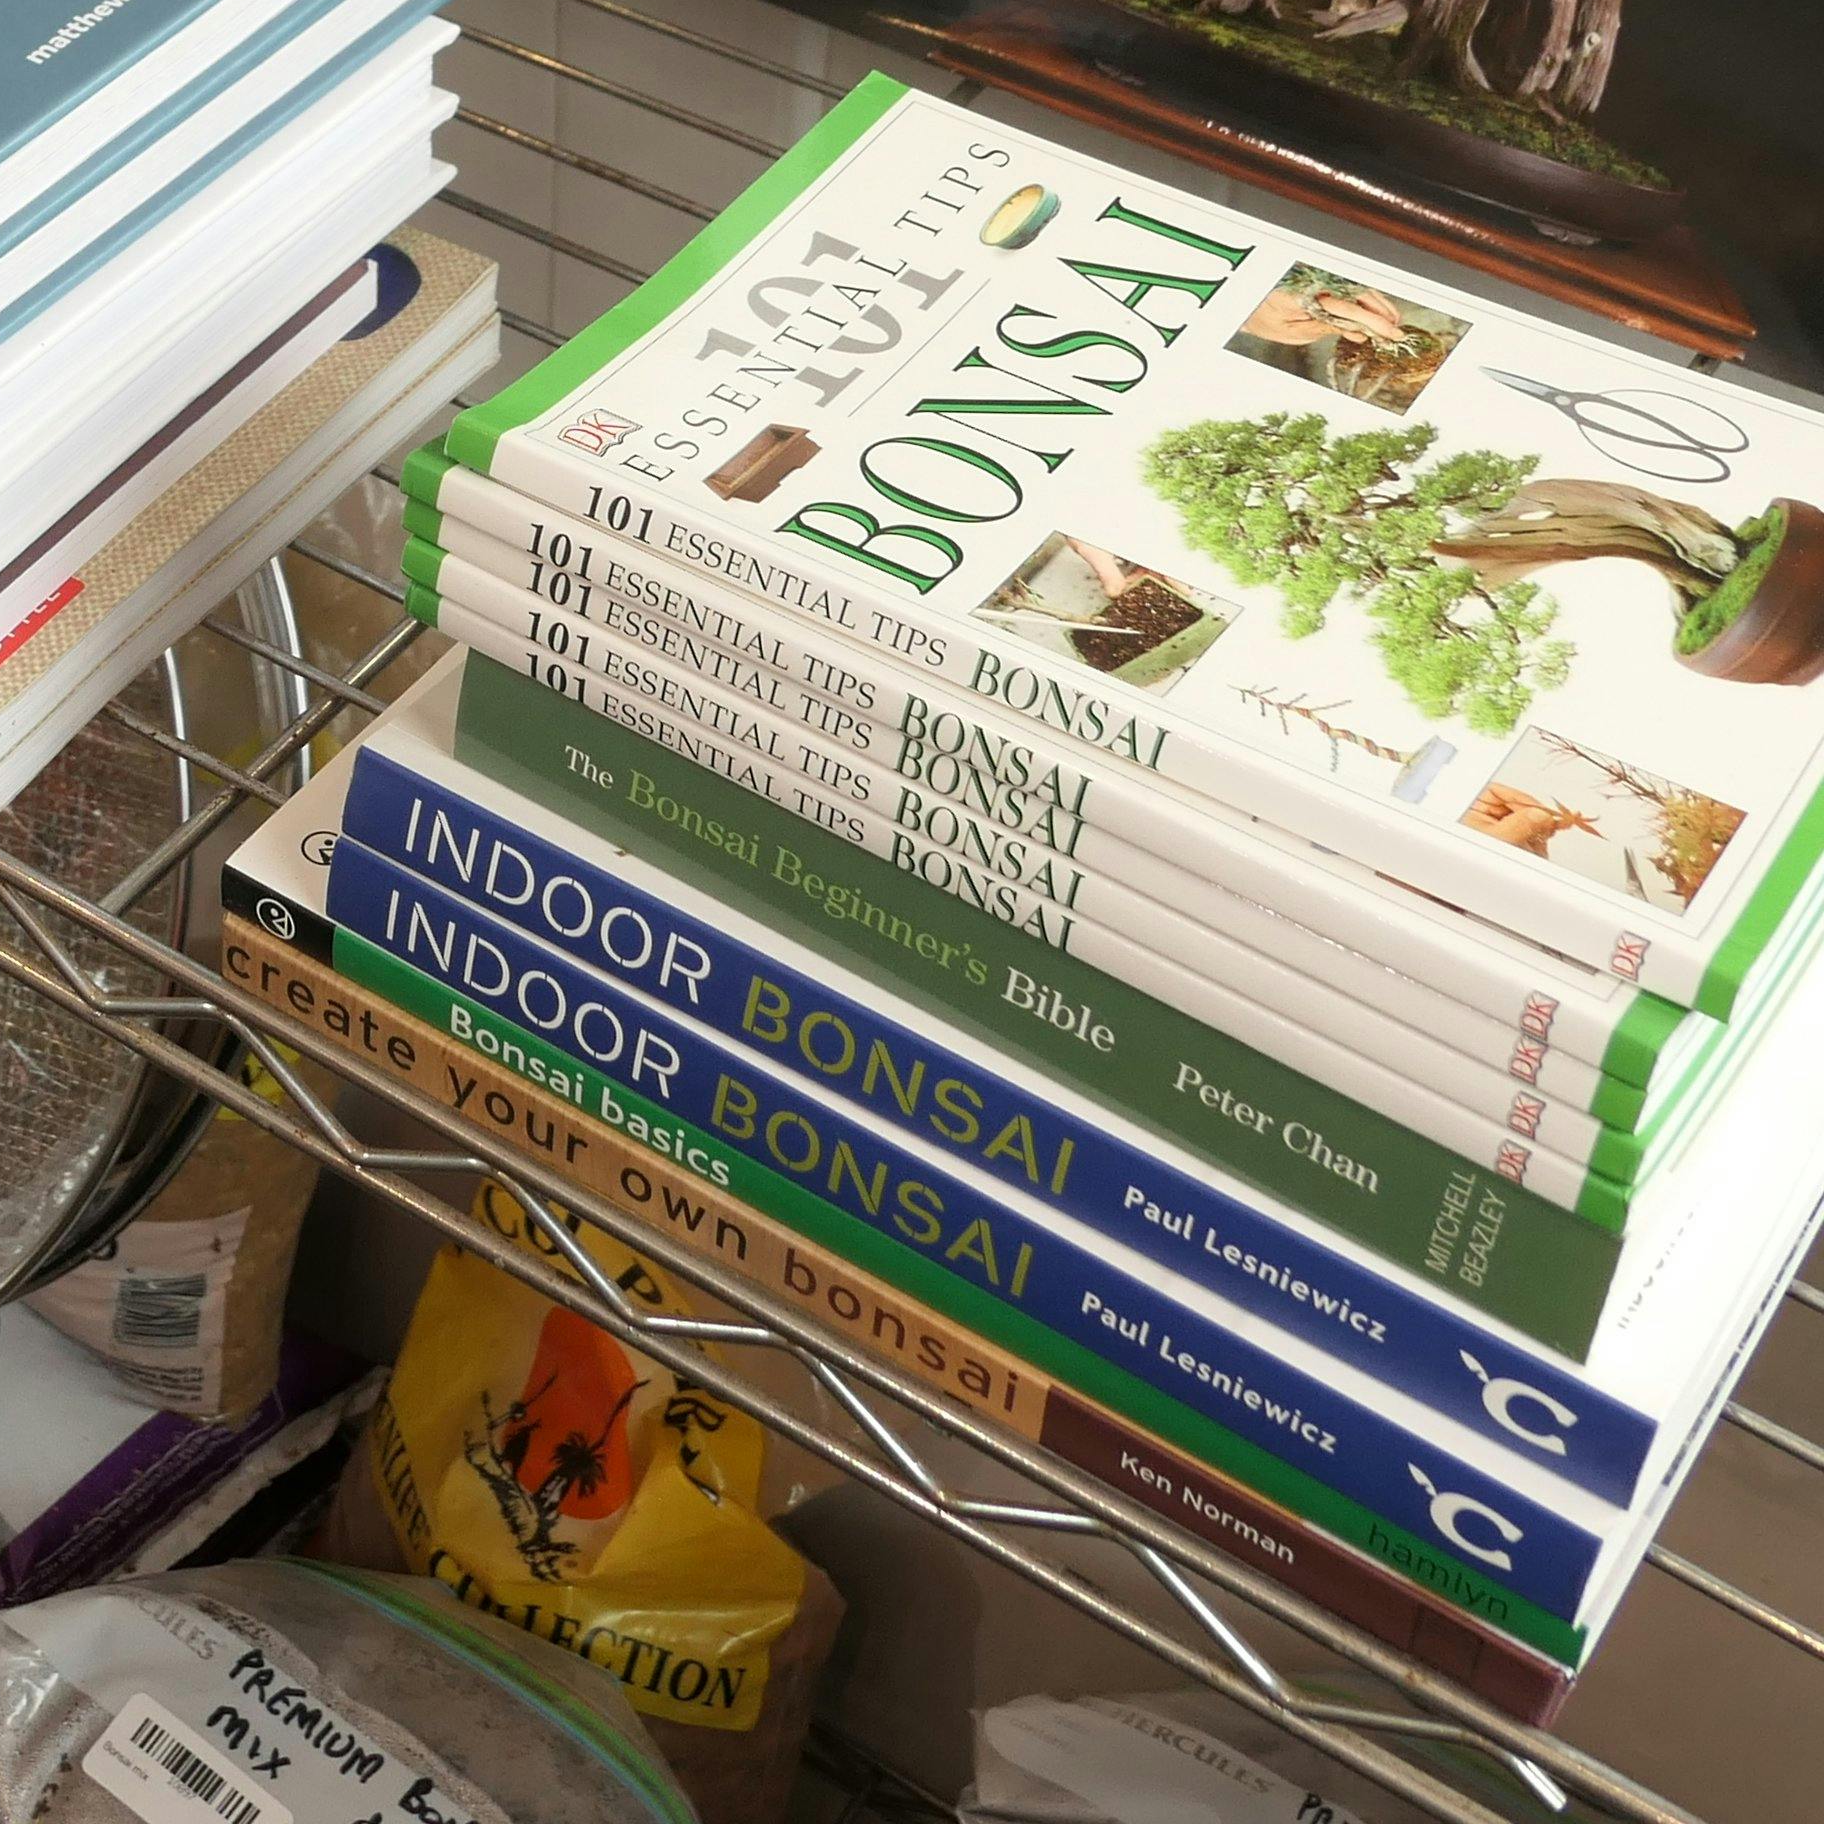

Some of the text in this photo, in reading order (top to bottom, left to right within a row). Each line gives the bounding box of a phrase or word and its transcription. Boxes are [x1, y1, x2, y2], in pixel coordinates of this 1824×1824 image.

[619, 142, 1012, 483] ESSENTIAL TIPS
[694, 230, 966, 409] 101
[773, 196, 1258, 596] BONSAI
[559, 410, 622, 454] DK
[526, 521, 1094, 820] 101 ESSENTIAL TIPS BONSAI
[582, 485, 1173, 772] 101 ESSENTIAL TIPS BONSAI
[525, 610, 1087, 911] 101 ESSENTIAL TIPS BONSAI
[404, 796, 1389, 1345] INDOOR BONSAI Paul Lesniewicz
[563, 743, 1381, 1195] The Bonsai Beginner's Bible Peter Chan
[225, 943, 418, 1073] create
[446, 1065, 590, 1166] your
[619, 1164, 748, 1261] own
[783, 1247, 1020, 1414] bonsai
[384, 887, 681, 1101] INDOOR
[711, 1073, 1034, 1299] BONSAI
[1080, 1289, 1149, 1348] Paul
[1159, 1332, 1339, 1456] Lesniewicz
[448, 1001, 732, 1189] Bonsai basics
[1423, 1170, 1477, 1275] MITCHELL
[1458, 1186, 1508, 1288] BEAZLEY
[1118, 1448, 1297, 1566] Ken Norman
[1367, 1520, 1511, 1622] hamlyn
[205, 1703, 293, 1781] MIX
[228, 1648, 386, 1785] PREMIUM
